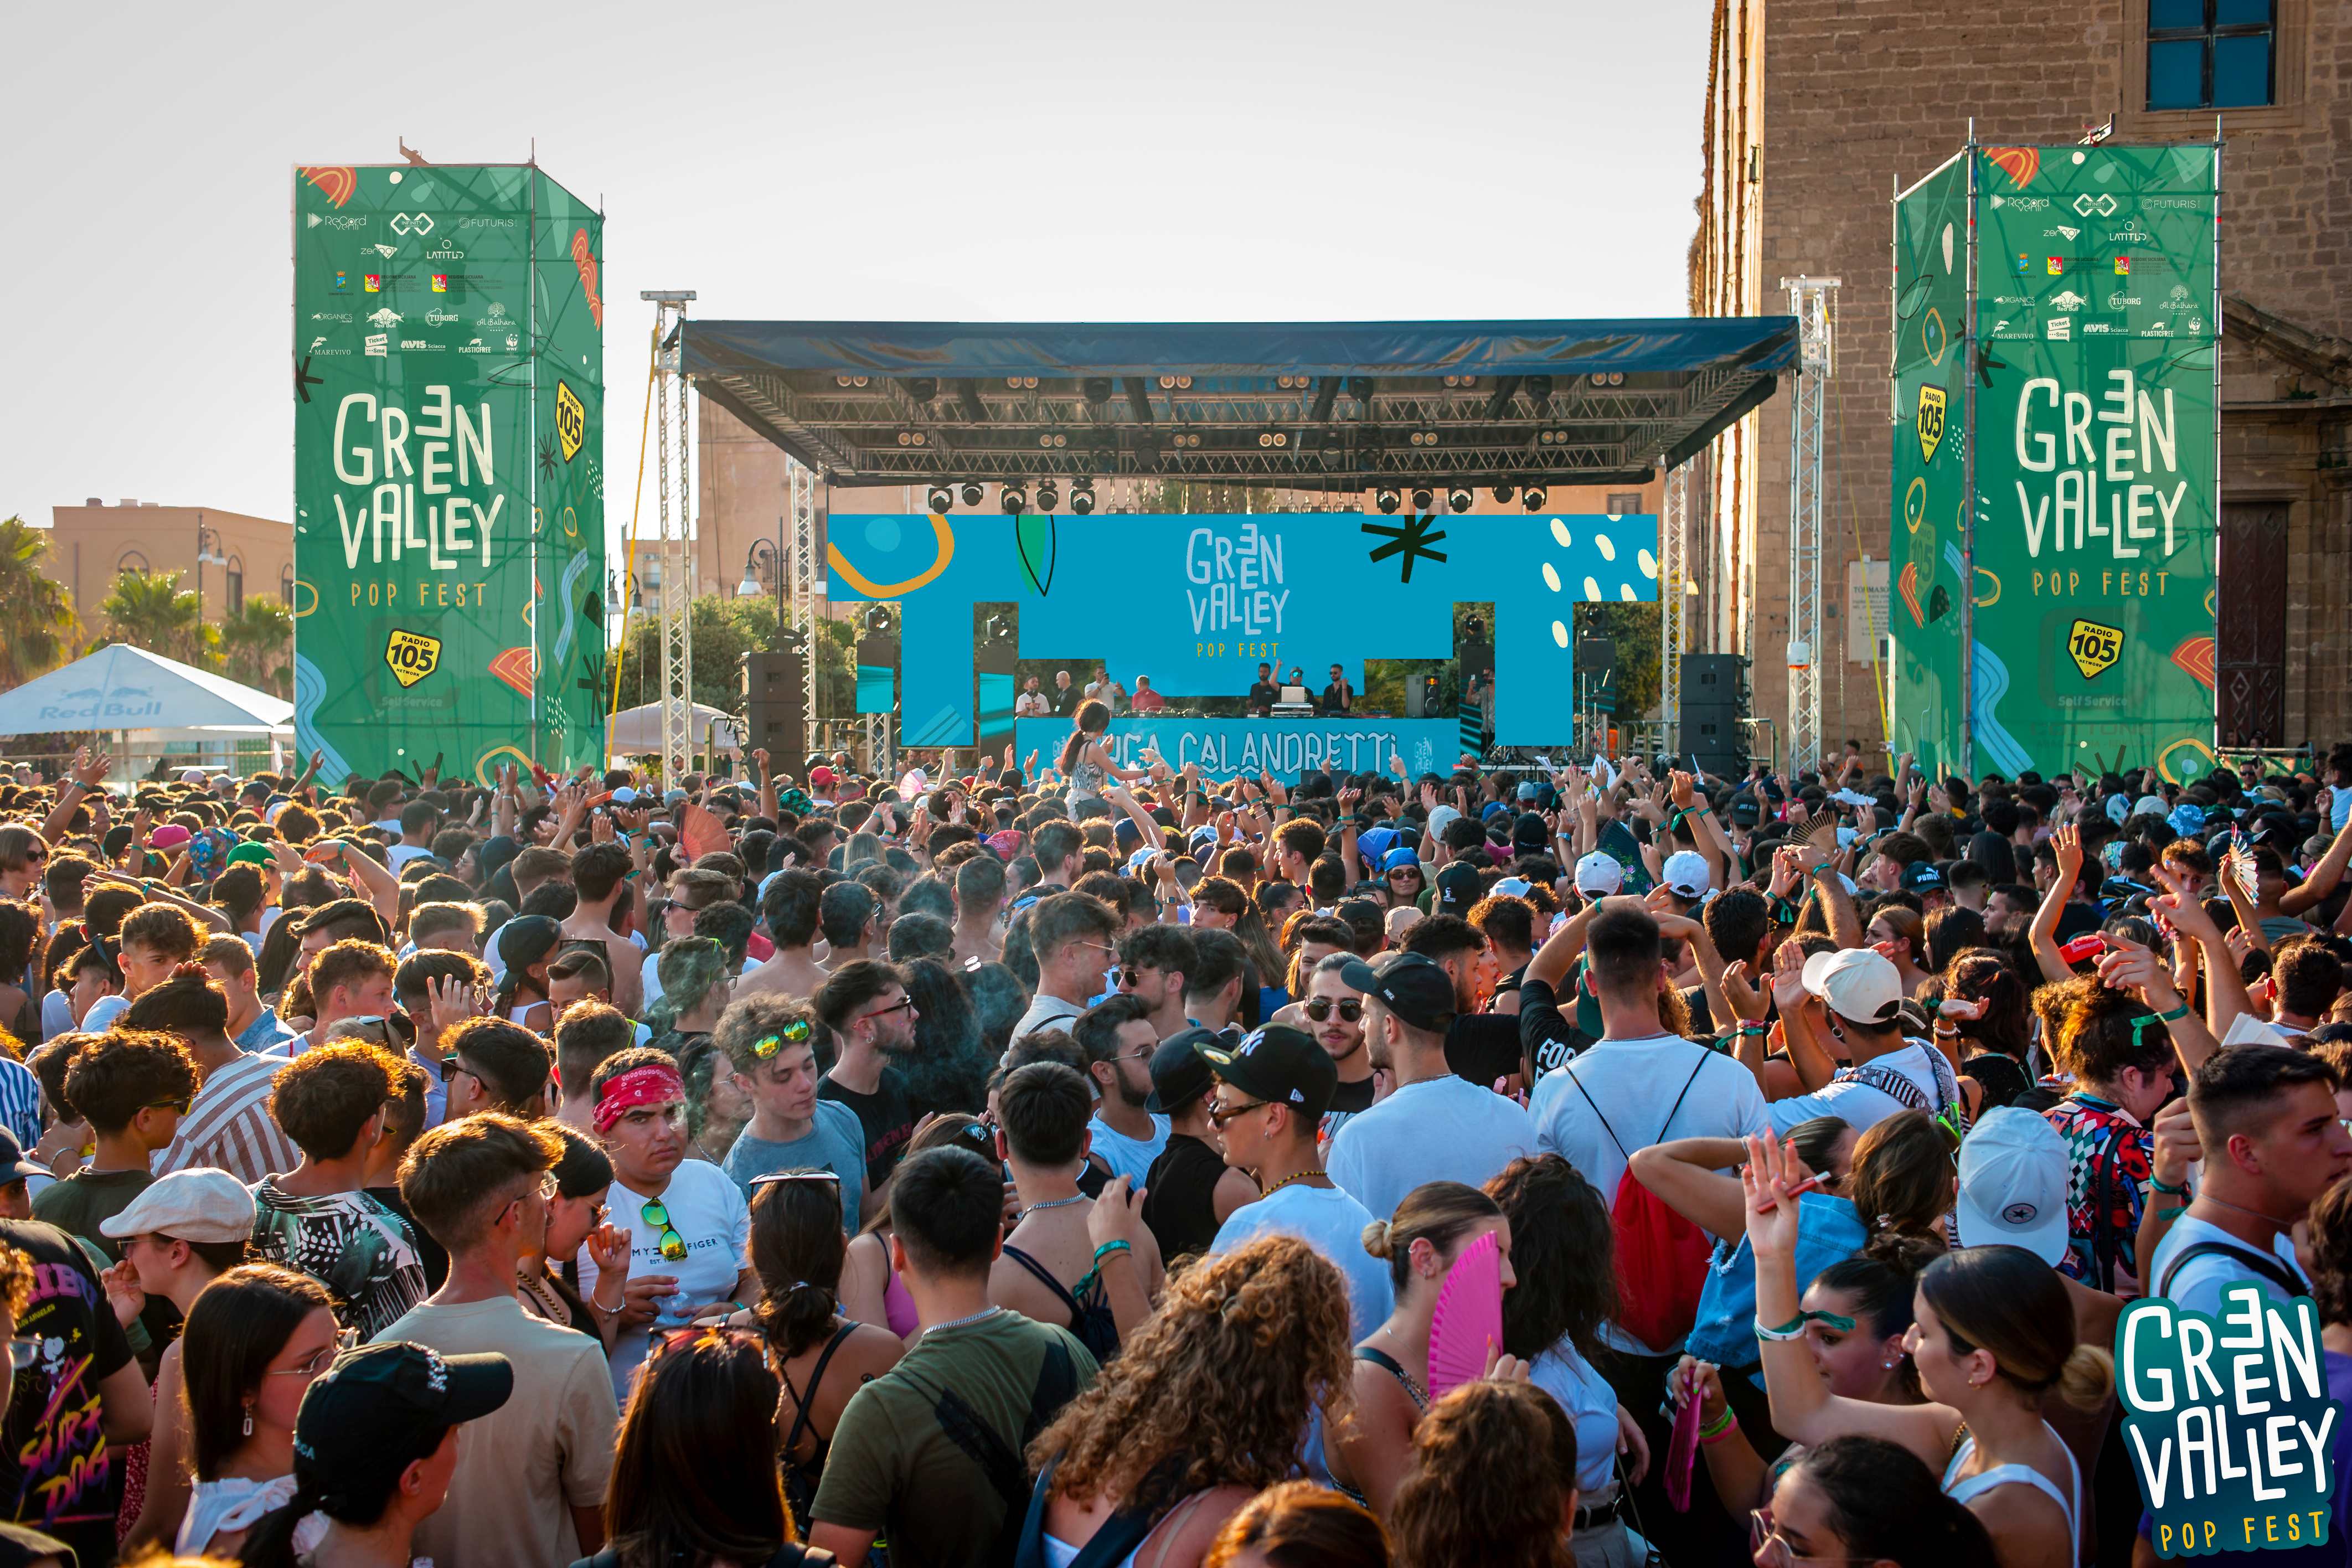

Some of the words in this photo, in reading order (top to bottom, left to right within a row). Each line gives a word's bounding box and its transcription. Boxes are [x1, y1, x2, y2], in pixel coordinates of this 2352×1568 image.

[2154, 200, 2196, 208] FUTURIS
[471, 219, 514, 227] FUTURIS
[2083, 324, 2109, 333] AVIS
[400, 340, 426, 349] AVIS
[564, 391, 579, 412] RADIO
[1925, 391, 1941, 404] RADIO
[559, 401, 581, 445] 105
[1920, 403, 1943, 439] 105
[2016, 370, 2176, 481] GREEN
[334, 385, 494, 494] GREEN
[2016, 470, 2188, 558] VALLEY
[333, 483, 504, 570] VALLEY
[1187, 523, 1283, 590] GREEN
[2033, 572, 2080, 596] POP
[2103, 571, 2170, 596] FEST
[351, 583, 398, 607] POP
[420, 583, 487, 607] FEST
[1186, 582, 1291, 636] VALLEY
[401, 635, 430, 647] RADIO
[2084, 625, 2113, 638] RADIO
[391, 643, 434, 672] 105
[1197, 642, 1225, 657] POP
[1239, 642, 1279, 658] FEST
[2074, 633, 2117, 662] 105
[396, 668, 420, 677] NETWORK
[2079, 659, 2103, 668] NETWORK
[39, 705, 100, 720] Red
[104, 702, 162, 718] Bull
